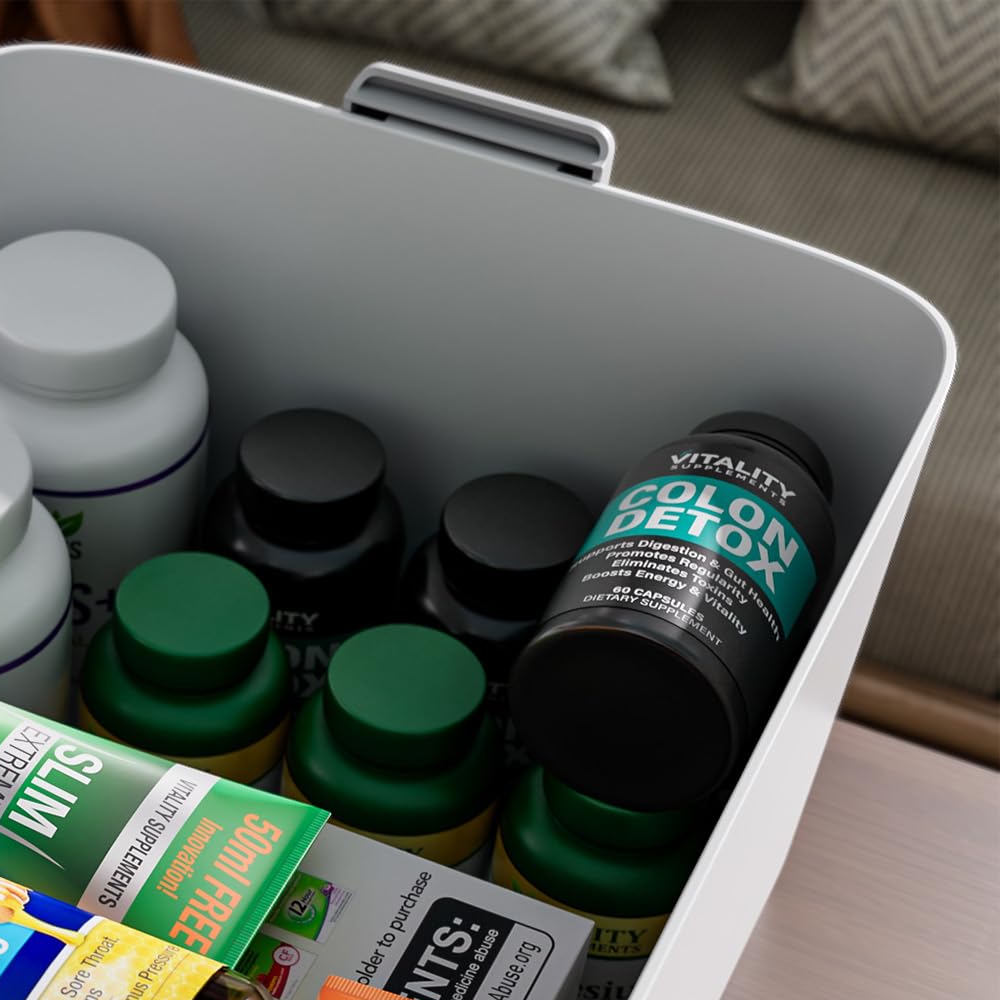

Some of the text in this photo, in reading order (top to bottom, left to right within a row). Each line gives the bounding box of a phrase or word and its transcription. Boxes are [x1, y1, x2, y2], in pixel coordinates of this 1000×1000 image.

[671, 452, 796, 499] VITALITY
[671, 464, 786, 507] SUPPLEMENTS
[605, 506, 785, 594] DETOX
[619, 481, 799, 568] COLON
[582, 569, 748, 635] Boosts Energy & Vitality
[606, 550, 748, 604] Promotes Regularity
[611, 559, 733, 607] Eliminates Toxins
[612, 586, 705, 622] 60 CAPSULES
[637, 540, 706, 562] Digestion
[709, 559, 721, 570] &
[724, 567, 748, 588] Gut
[748, 588, 780, 641] Health
[583, 593, 723, 646] DIETARY SUPPLEMENT
[8, 744, 103, 838] SLIM
[98, 779, 198, 908] VITALITY SUPPLEMENTS
[157, 817, 223, 900] Innovation!
[214, 813, 283, 886] 50ml
[169, 874, 242, 955] FREE
[377, 932, 395, 948] to
[390, 871, 432, 933] purchase
[61, 967, 91, 998] Sore
[81, 935, 119, 970] Throat,
[138, 944, 181, 982] Pressure
[474, 929, 499, 962] abuse
